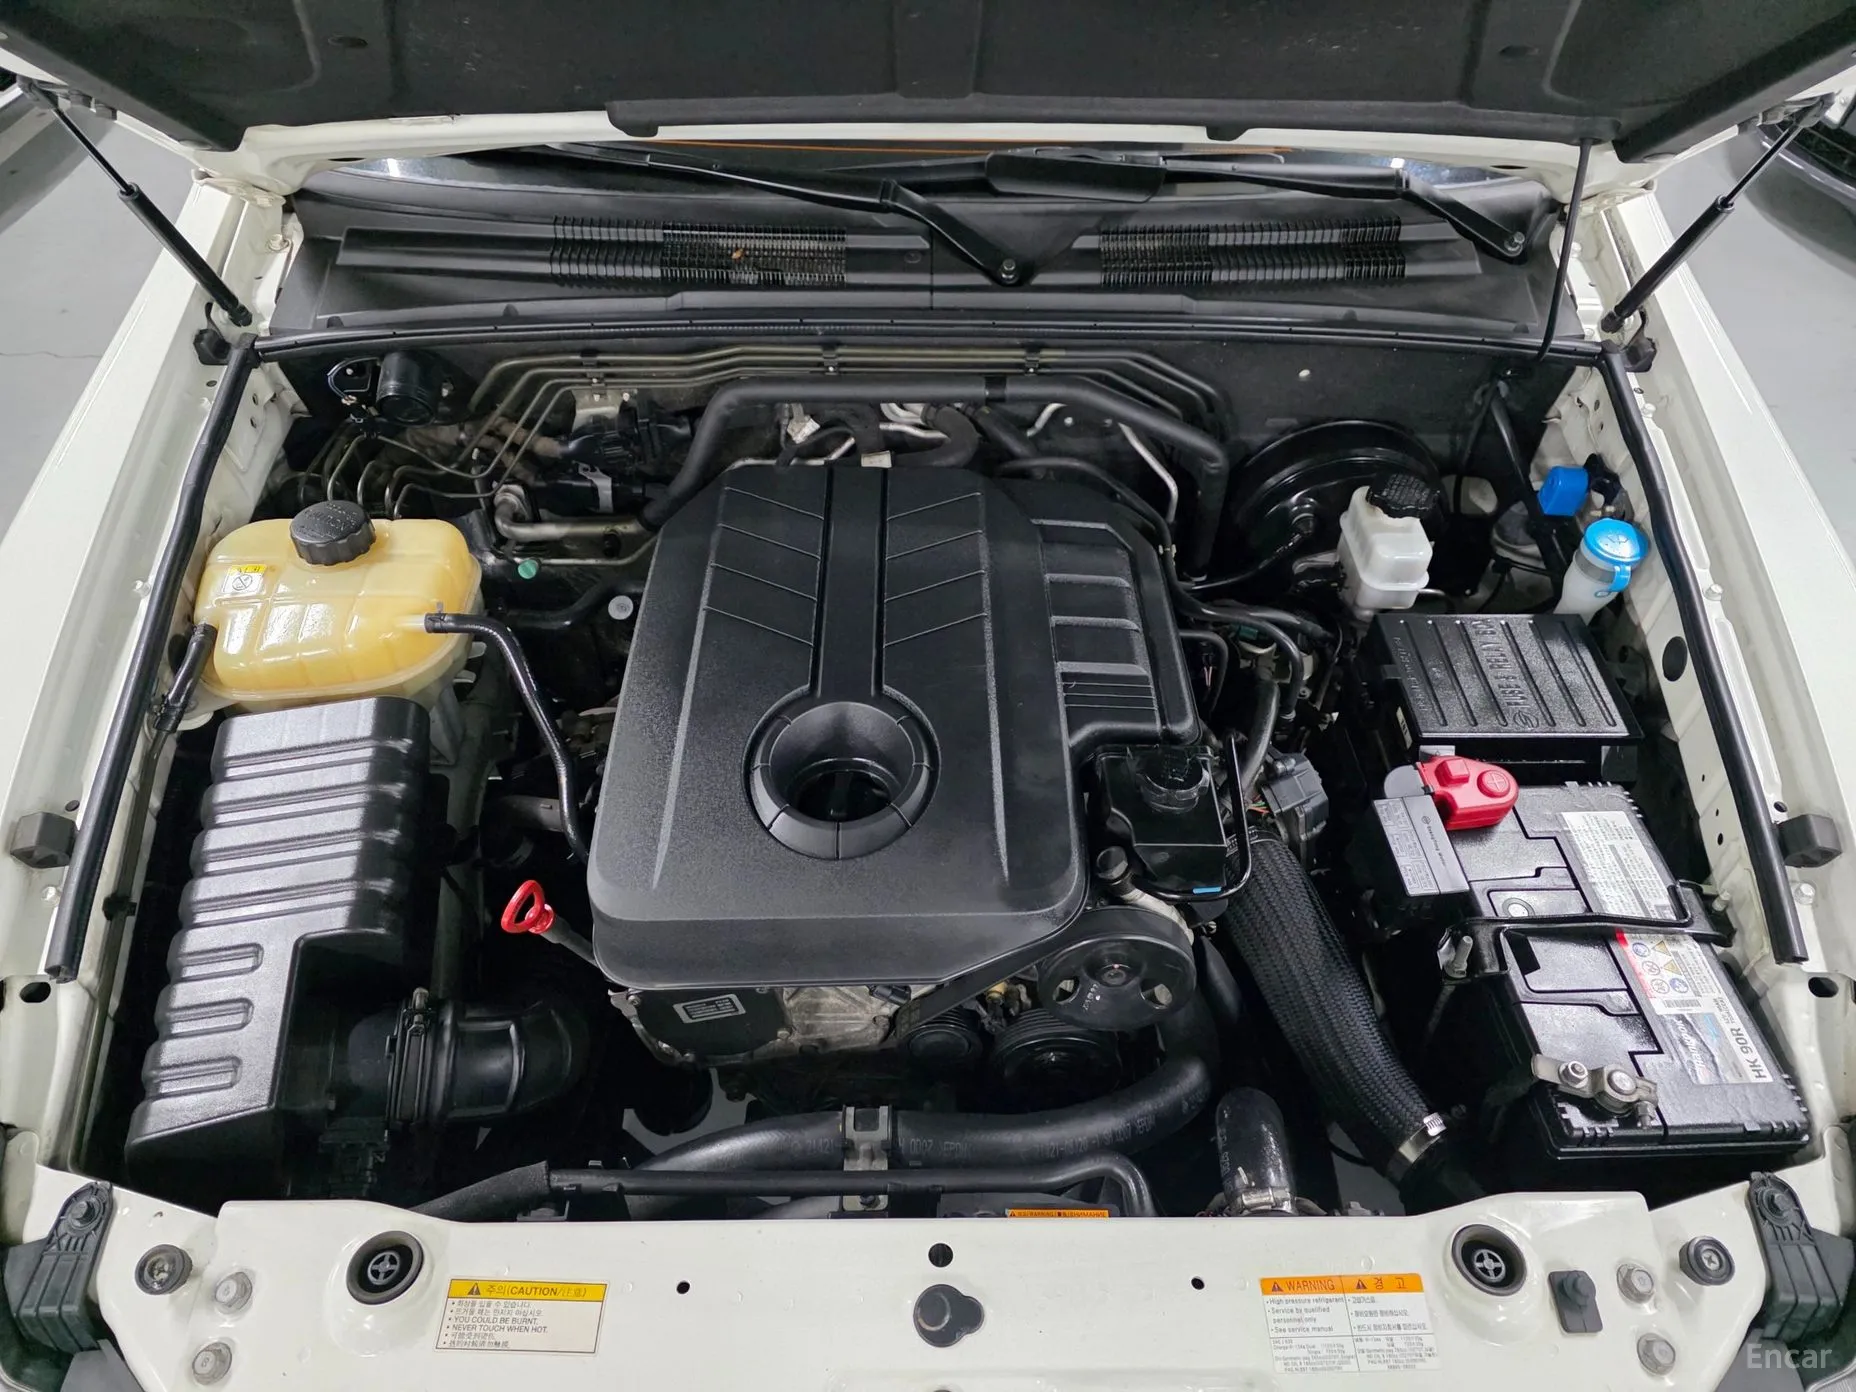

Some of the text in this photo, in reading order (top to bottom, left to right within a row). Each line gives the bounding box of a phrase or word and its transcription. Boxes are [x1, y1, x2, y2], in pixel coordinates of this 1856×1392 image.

[1731, 1027, 1768, 1080] HK 90R
[1286, 1279, 1335, 1291] WARNING
[1304, 1306, 1330, 1314] qualified
[471, 1316, 497, 1324] COULD
[511, 1317, 538, 1325] BURNT.
[1303, 1315, 1316, 1323] only
[452, 1324, 477, 1332] NEVER
[479, 1324, 505, 1332] TOUCH
[507, 1325, 530, 1333] WHEN
